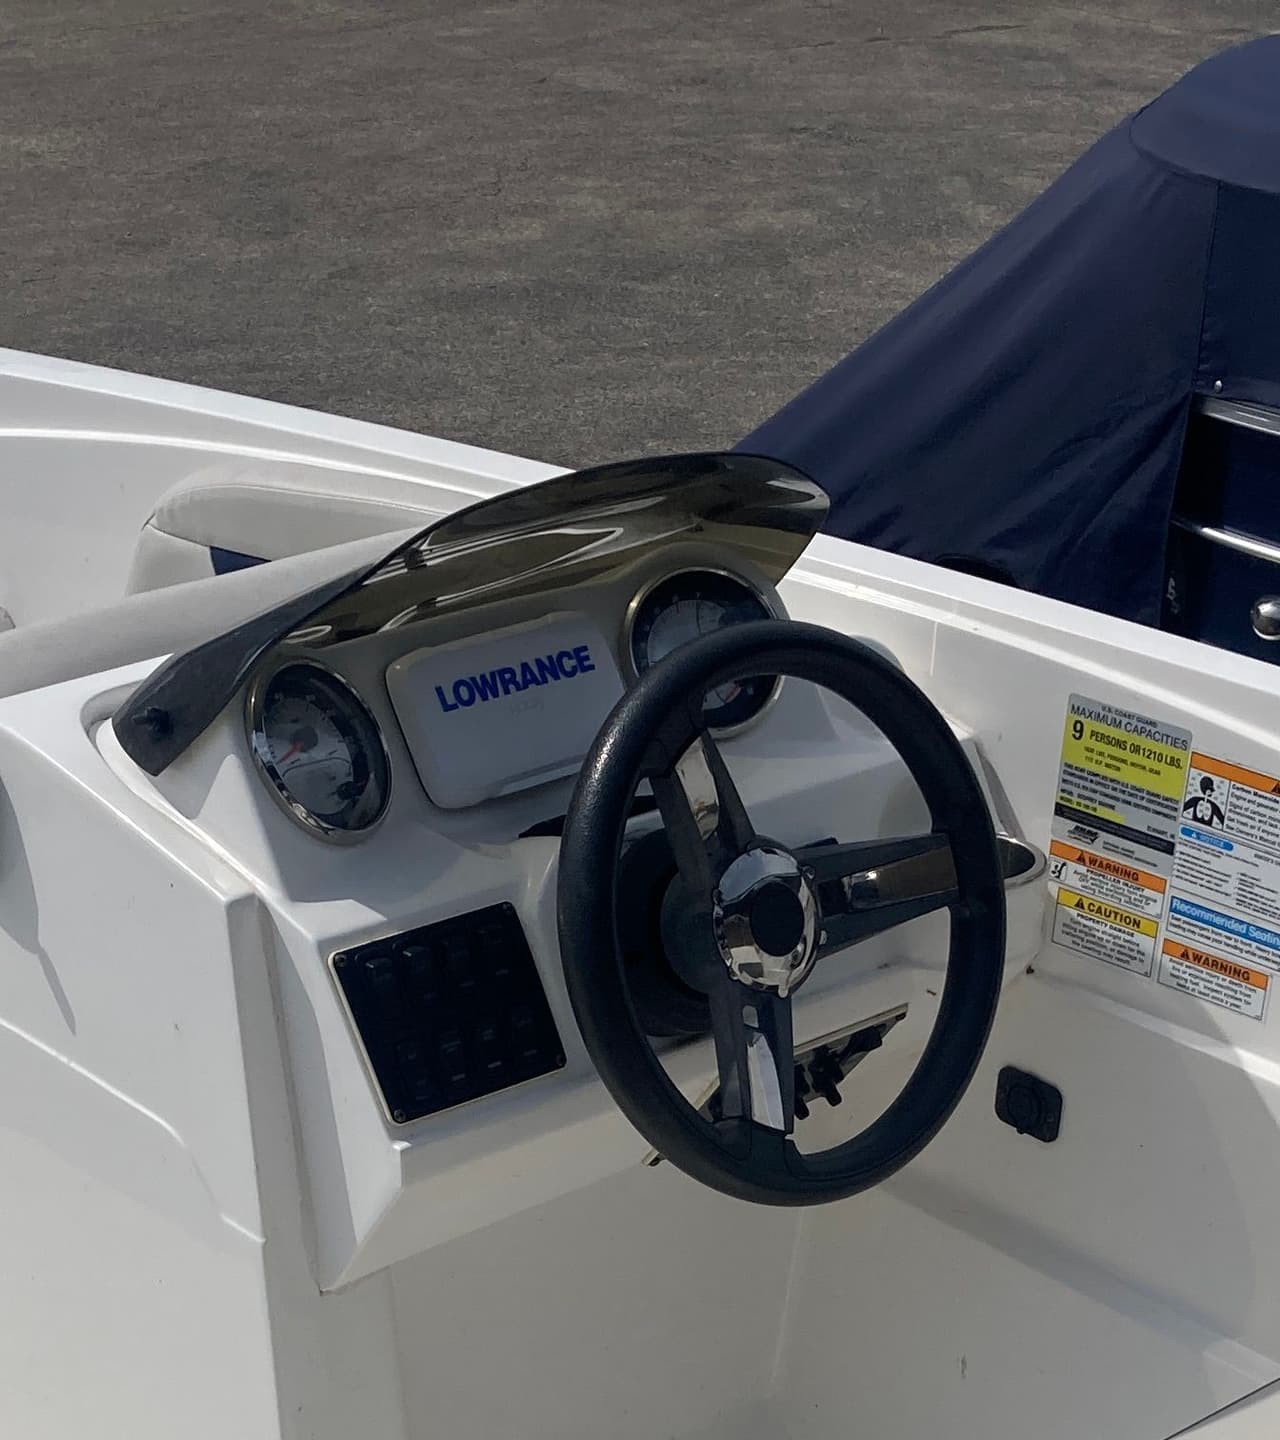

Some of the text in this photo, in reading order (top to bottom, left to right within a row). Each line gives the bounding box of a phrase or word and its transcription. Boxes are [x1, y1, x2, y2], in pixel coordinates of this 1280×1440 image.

[435, 645, 596, 712] LOWRANCE
[1070, 703, 1188, 751] MAXIMUM CAPACITIES
[1071, 718, 1084, 741] 9
[1089, 729, 1127, 751] PERSONS
[1129, 742, 1141, 756] OR
[1141, 746, 1163, 763] 1210
[1164, 753, 1183, 769] LBS.
[1088, 855, 1139, 881] WARNING
[1076, 912, 1134, 937] PROPERTY DAMAGE
[1086, 902, 1140, 929] CAUTION
[1171, 897, 1246, 933] Recommended
[1191, 952, 1250, 981] WARNING
